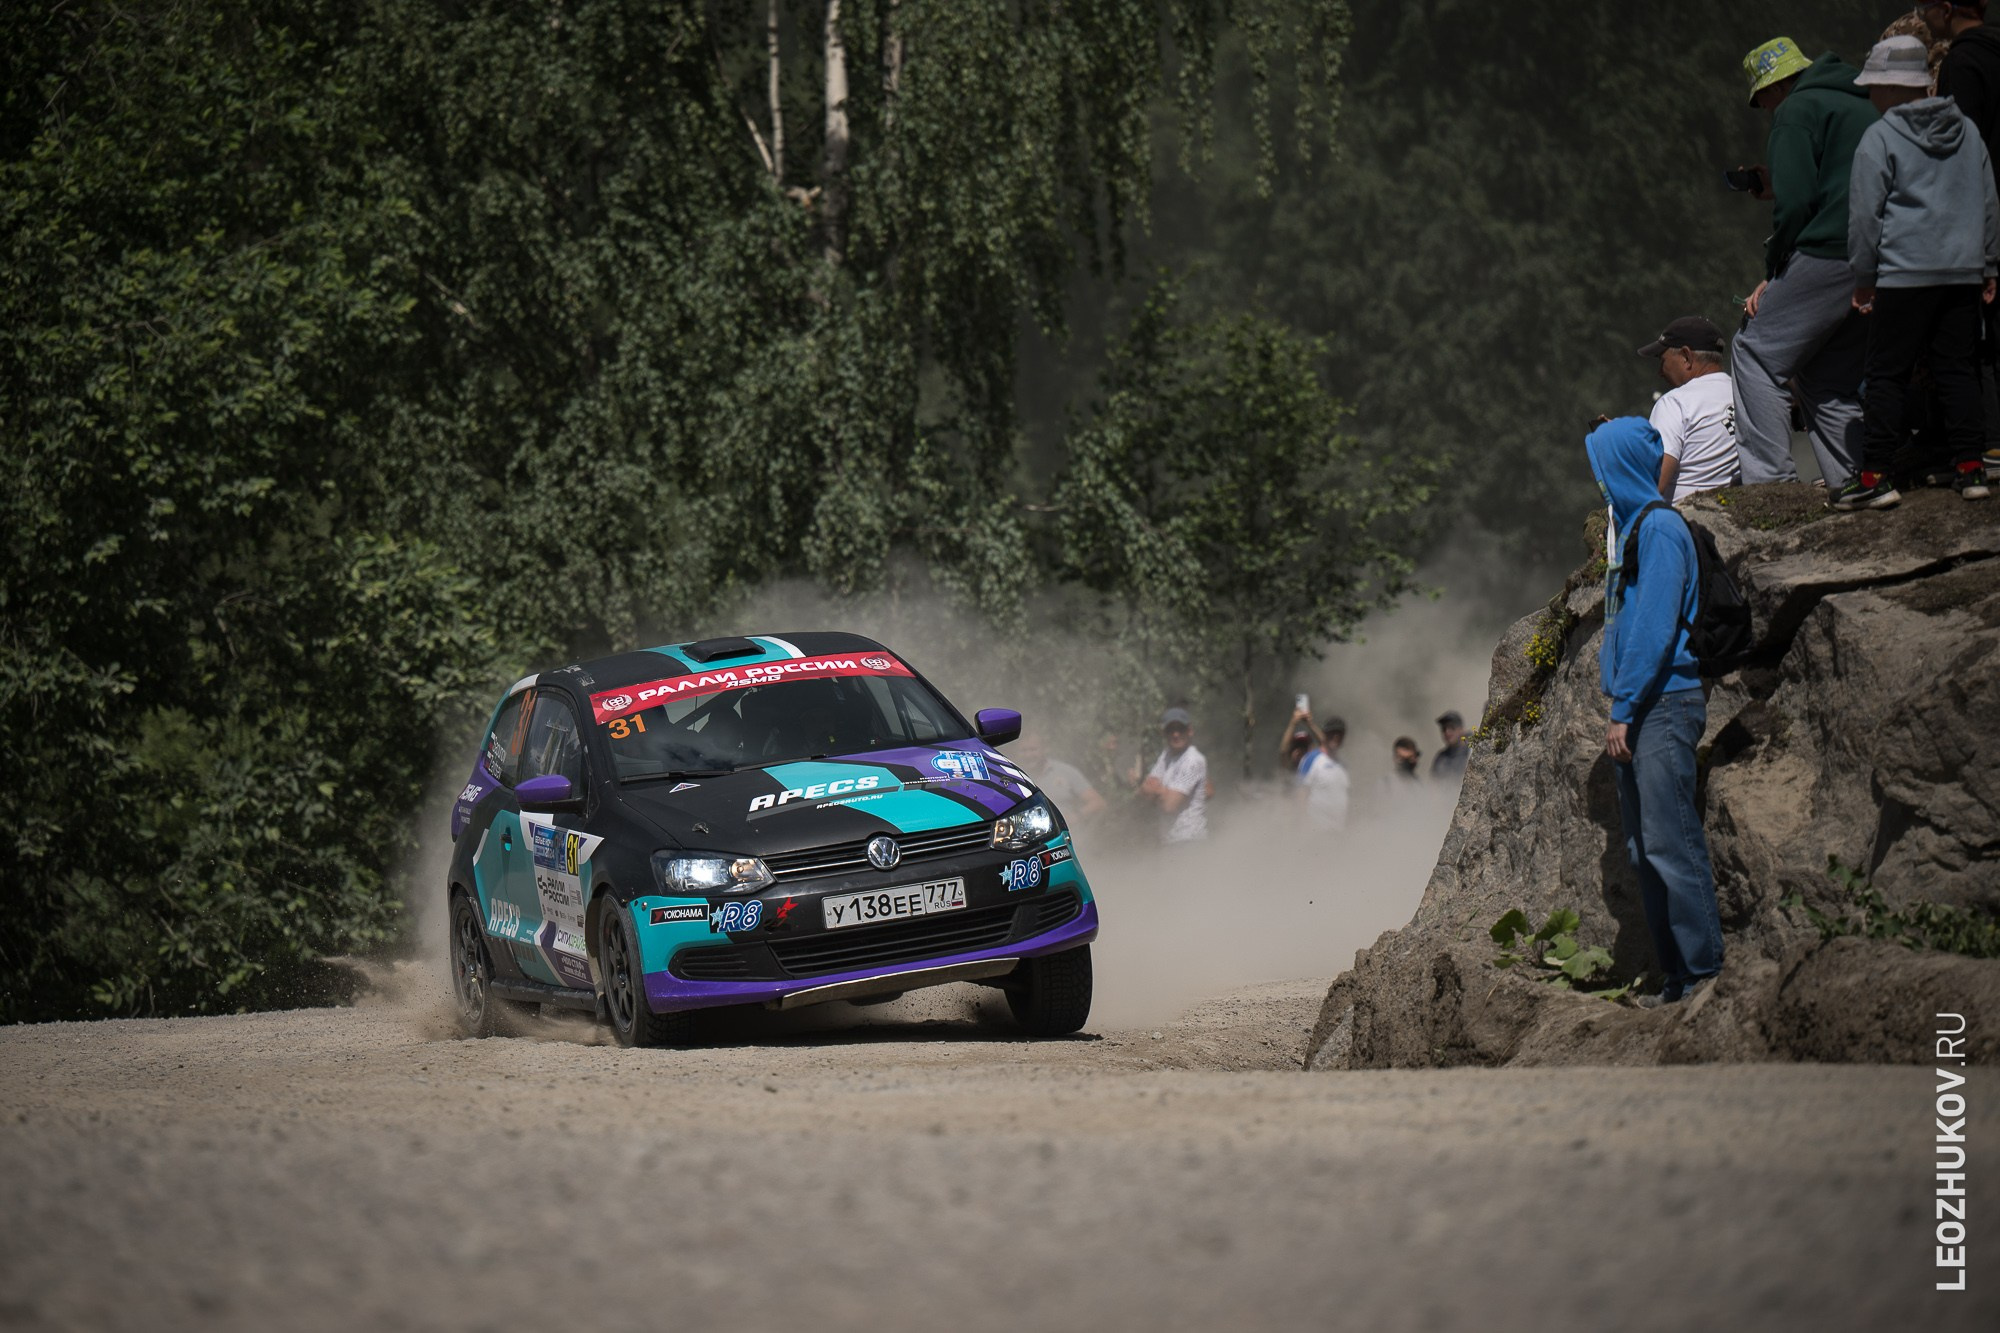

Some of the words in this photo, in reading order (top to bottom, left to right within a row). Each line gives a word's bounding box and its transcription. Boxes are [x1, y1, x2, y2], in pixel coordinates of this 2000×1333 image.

[637, 671, 738, 701] РАЛЛИ
[745, 660, 857, 678] РОССИИ
[511, 689, 538, 756] 31
[608, 713, 647, 739] 31
[749, 775, 880, 812] APECS
[816, 794, 884, 809] APECSAUTO.RU
[567, 834, 579, 875] 31
[547, 877, 566, 892] РАЛЛИ
[1008, 856, 1041, 891] R8
[548, 889, 570, 907] РОССИИ
[925, 881, 958, 903] 777
[934, 900, 951, 909] RUS
[488, 898, 520, 938] APECS
[663, 908, 703, 920] YOKOHAMA
[717, 900, 763, 932] R8
